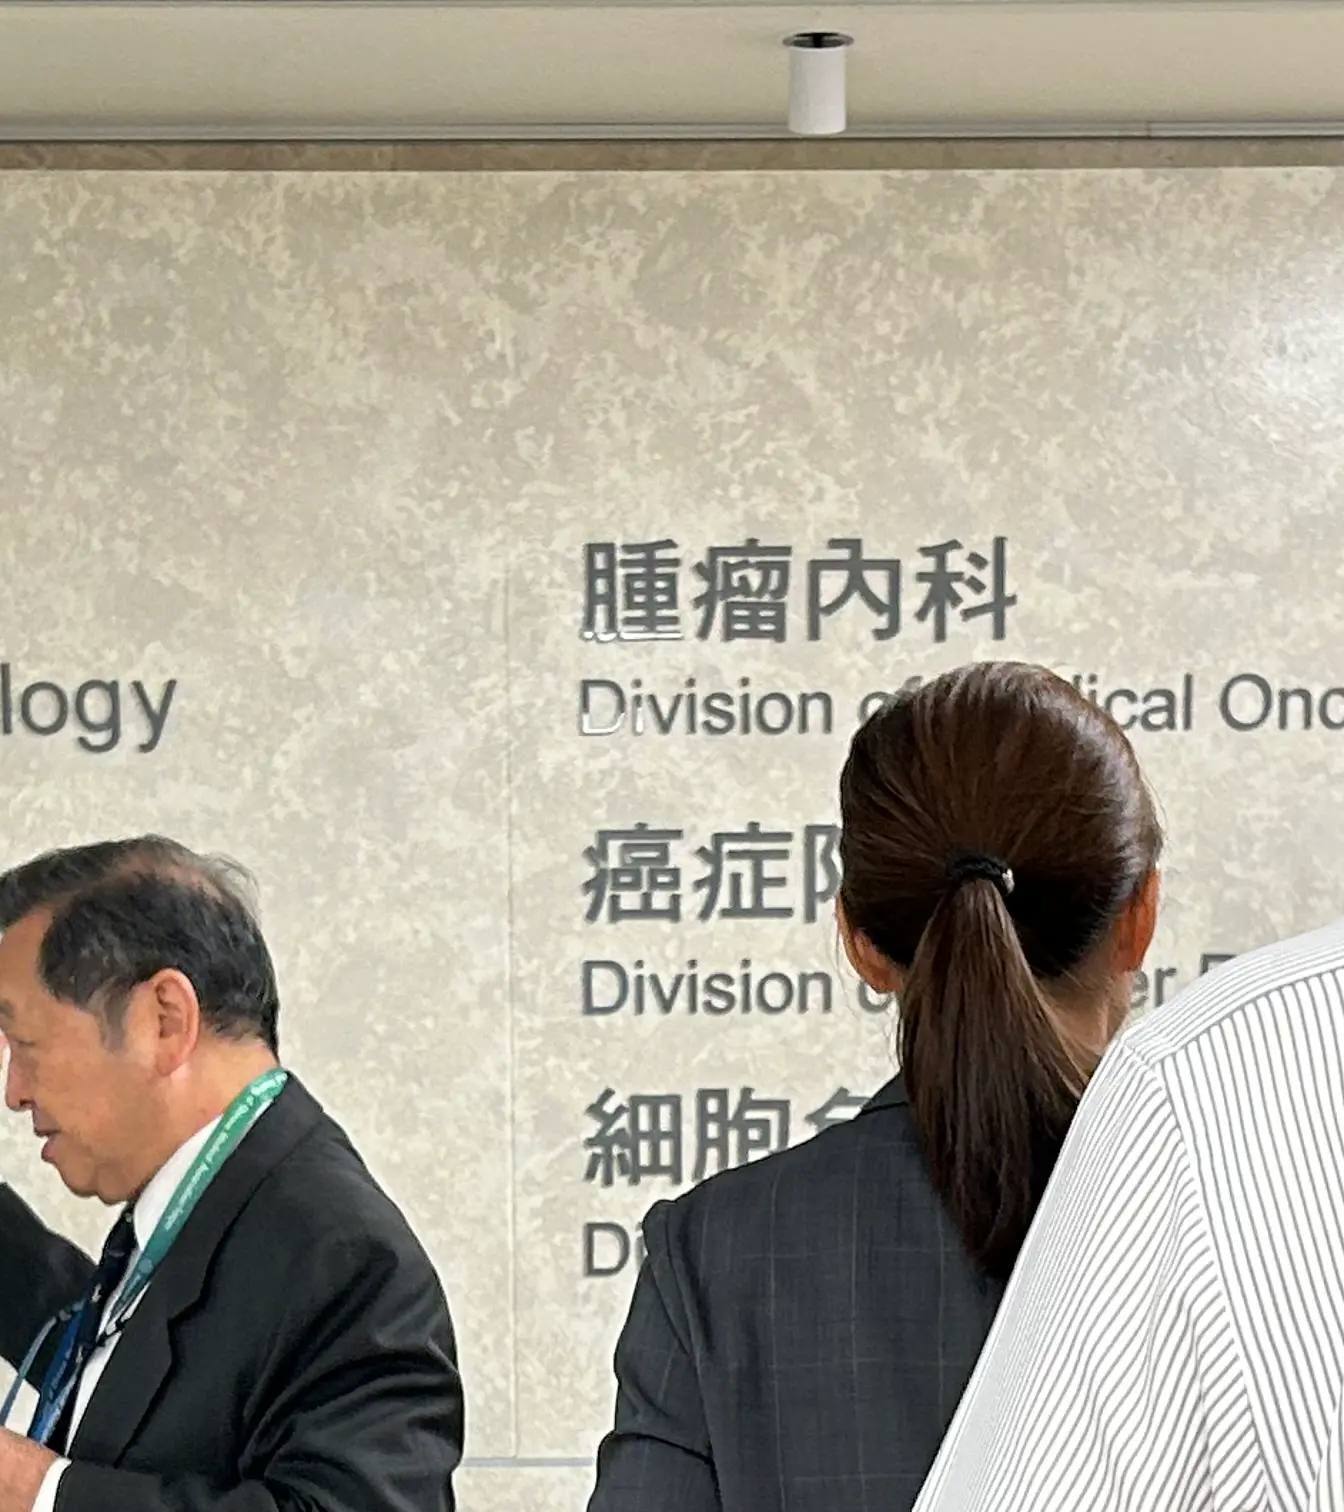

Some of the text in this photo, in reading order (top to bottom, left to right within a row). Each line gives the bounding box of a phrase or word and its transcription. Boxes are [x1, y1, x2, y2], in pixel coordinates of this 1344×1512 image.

[580, 536, 1017, 642] 腫瘤內科
[578, 675, 833, 736] Division
[581, 822, 843, 924] 癌症
[582, 958, 833, 1015] Division
